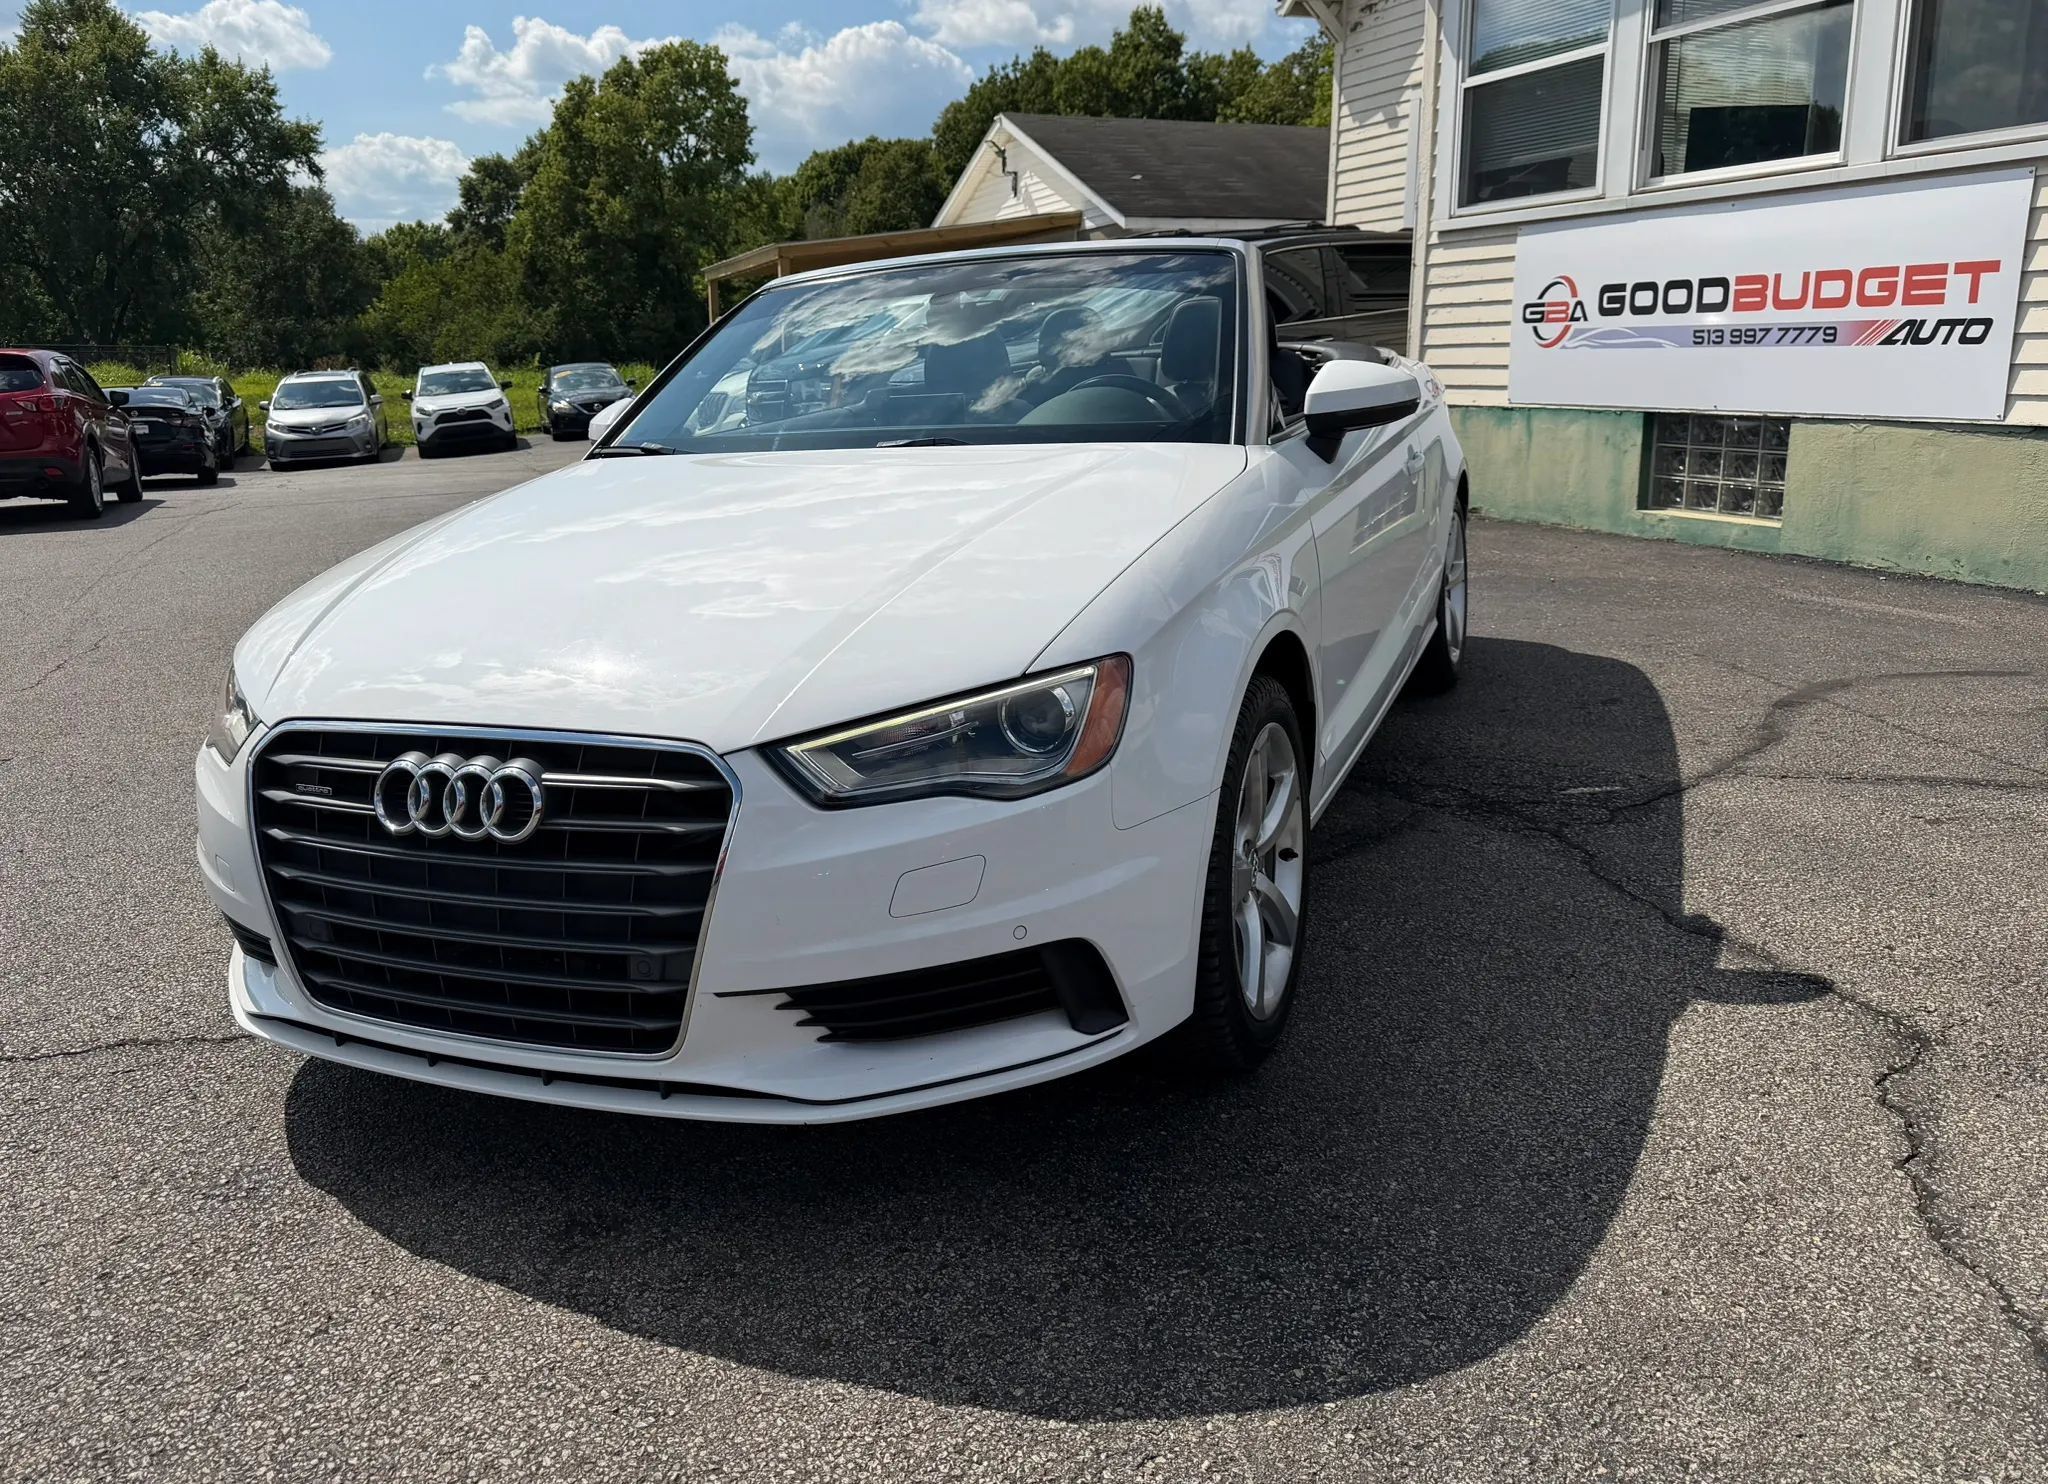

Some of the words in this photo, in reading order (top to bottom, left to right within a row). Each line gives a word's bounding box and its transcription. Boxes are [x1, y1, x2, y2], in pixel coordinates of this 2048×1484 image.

[1522, 300, 1588, 324] GBA
[1692, 329, 1724, 346] 513
[1729, 327, 1774, 345] 997
[1775, 325, 1838, 344] 7779
[1876, 317, 1994, 346] AUTO
